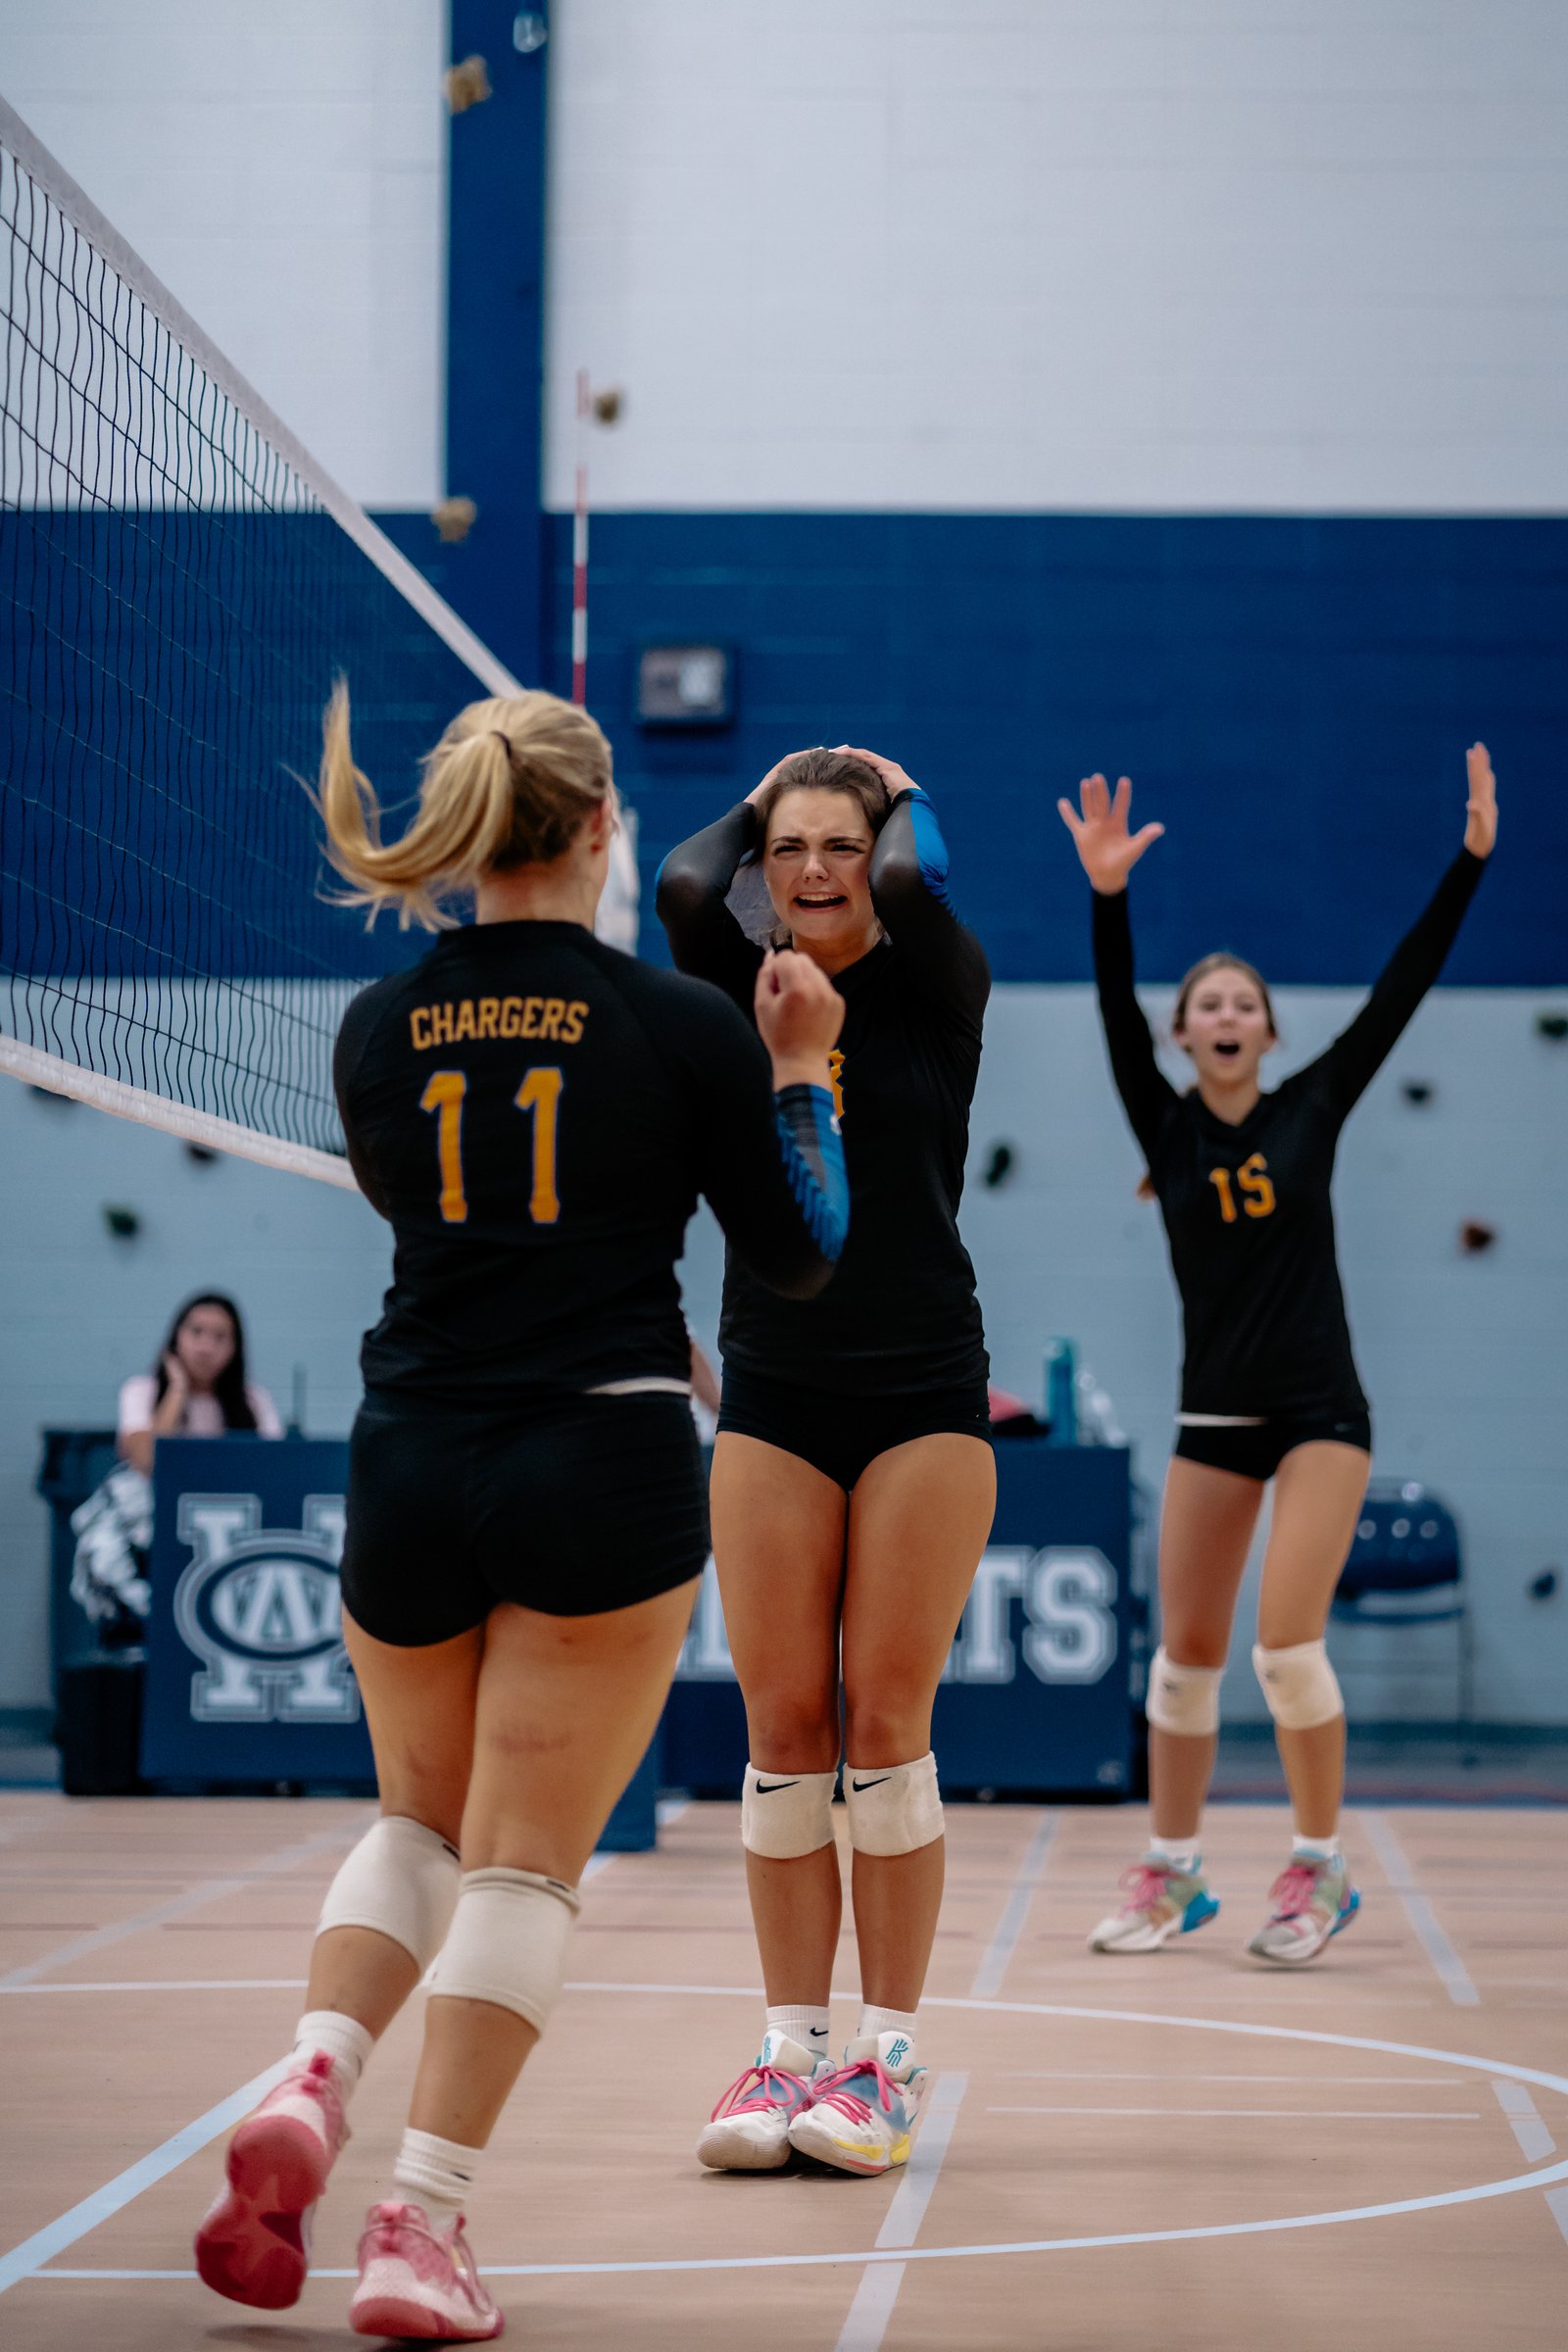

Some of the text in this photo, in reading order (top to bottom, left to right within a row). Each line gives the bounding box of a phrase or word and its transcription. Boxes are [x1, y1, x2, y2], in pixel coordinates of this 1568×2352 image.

[410, 996, 589, 1051] CHARGERS
[419, 1066, 563, 1224] 11
[1208, 1152, 1277, 1223] 15
